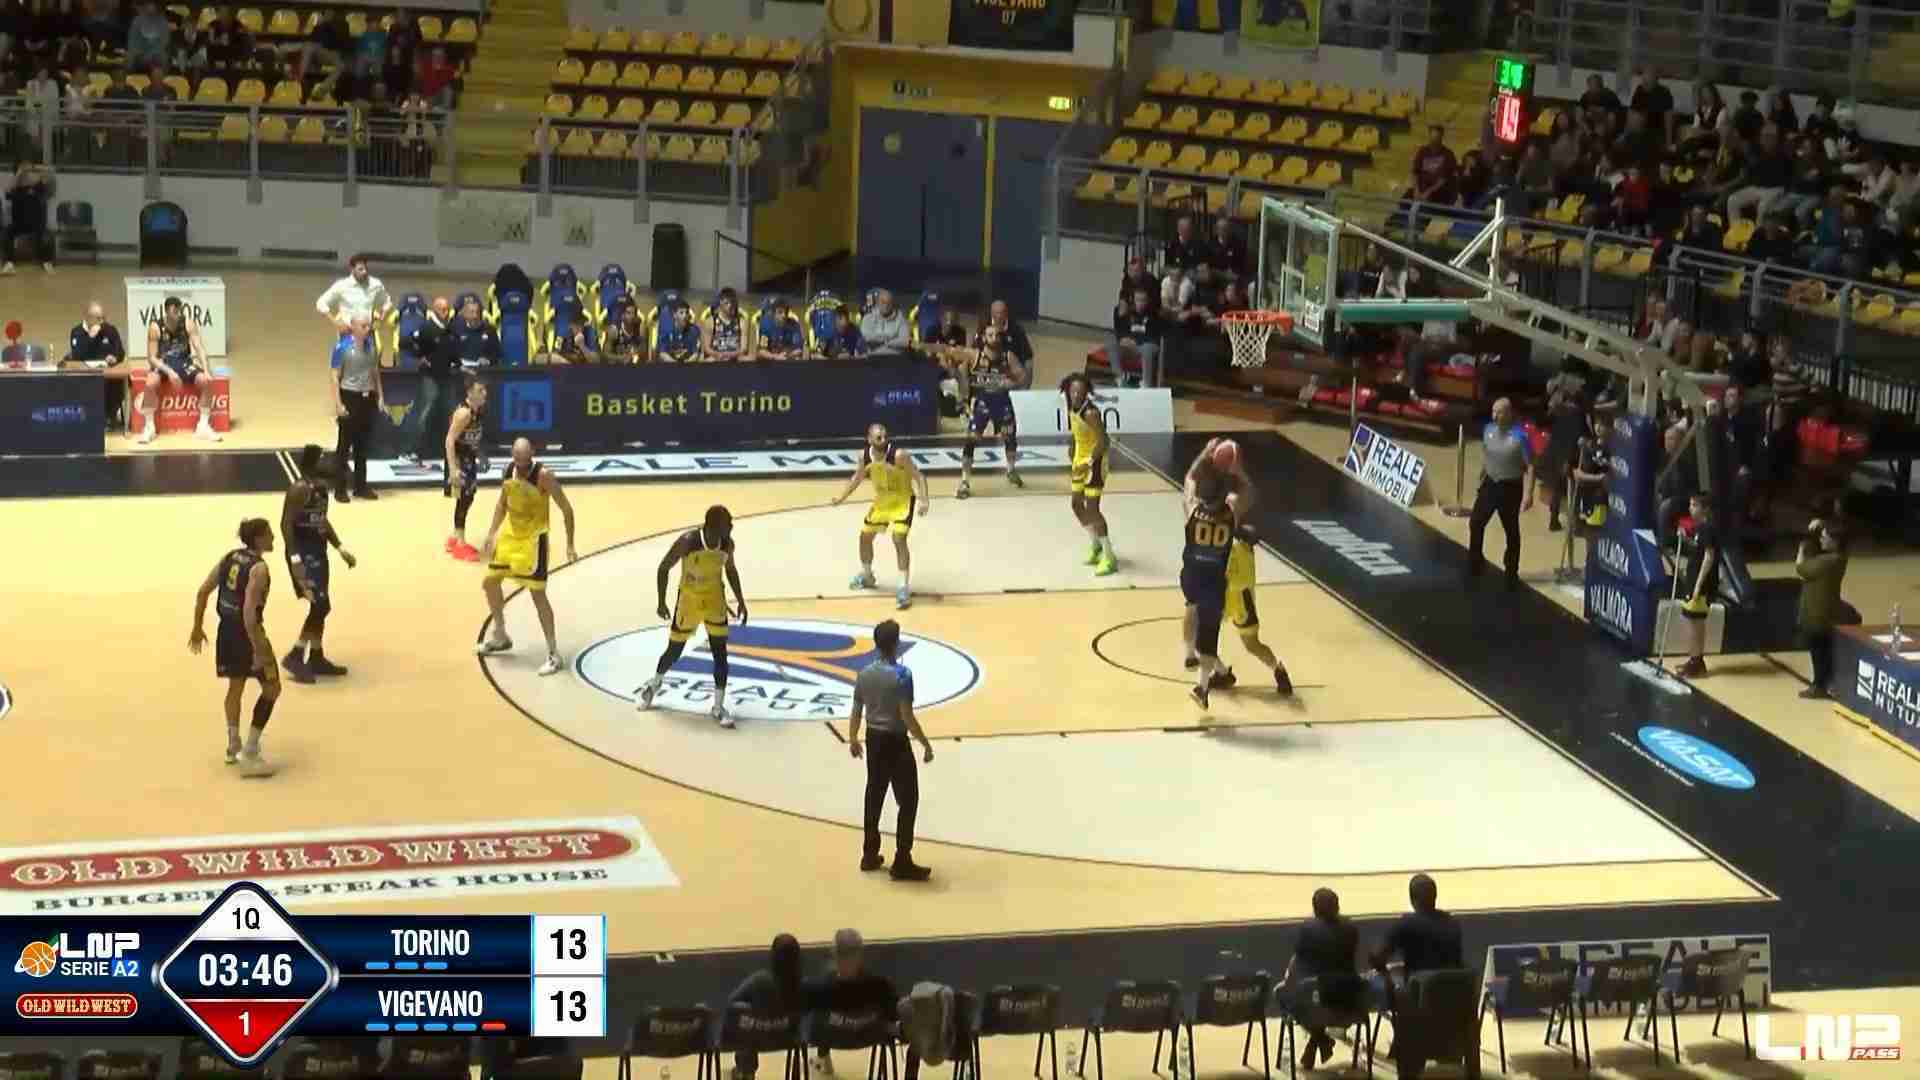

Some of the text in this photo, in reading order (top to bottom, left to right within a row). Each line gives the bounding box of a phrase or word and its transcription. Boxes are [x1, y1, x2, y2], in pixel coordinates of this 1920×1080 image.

[139, 302, 214, 328] VALORA
[160, 394, 228, 410] DURG
[586, 391, 792, 416] Basket Torino
[1373, 438, 1424, 486] REALE
[1195, 521, 1230, 546] 00
[1877, 669, 1920, 712] REAL
[11, 832, 601, 885] OLD WILD WEST
[283, 876, 440, 896] STEAK
[454, 867, 609, 887] HOUSE
